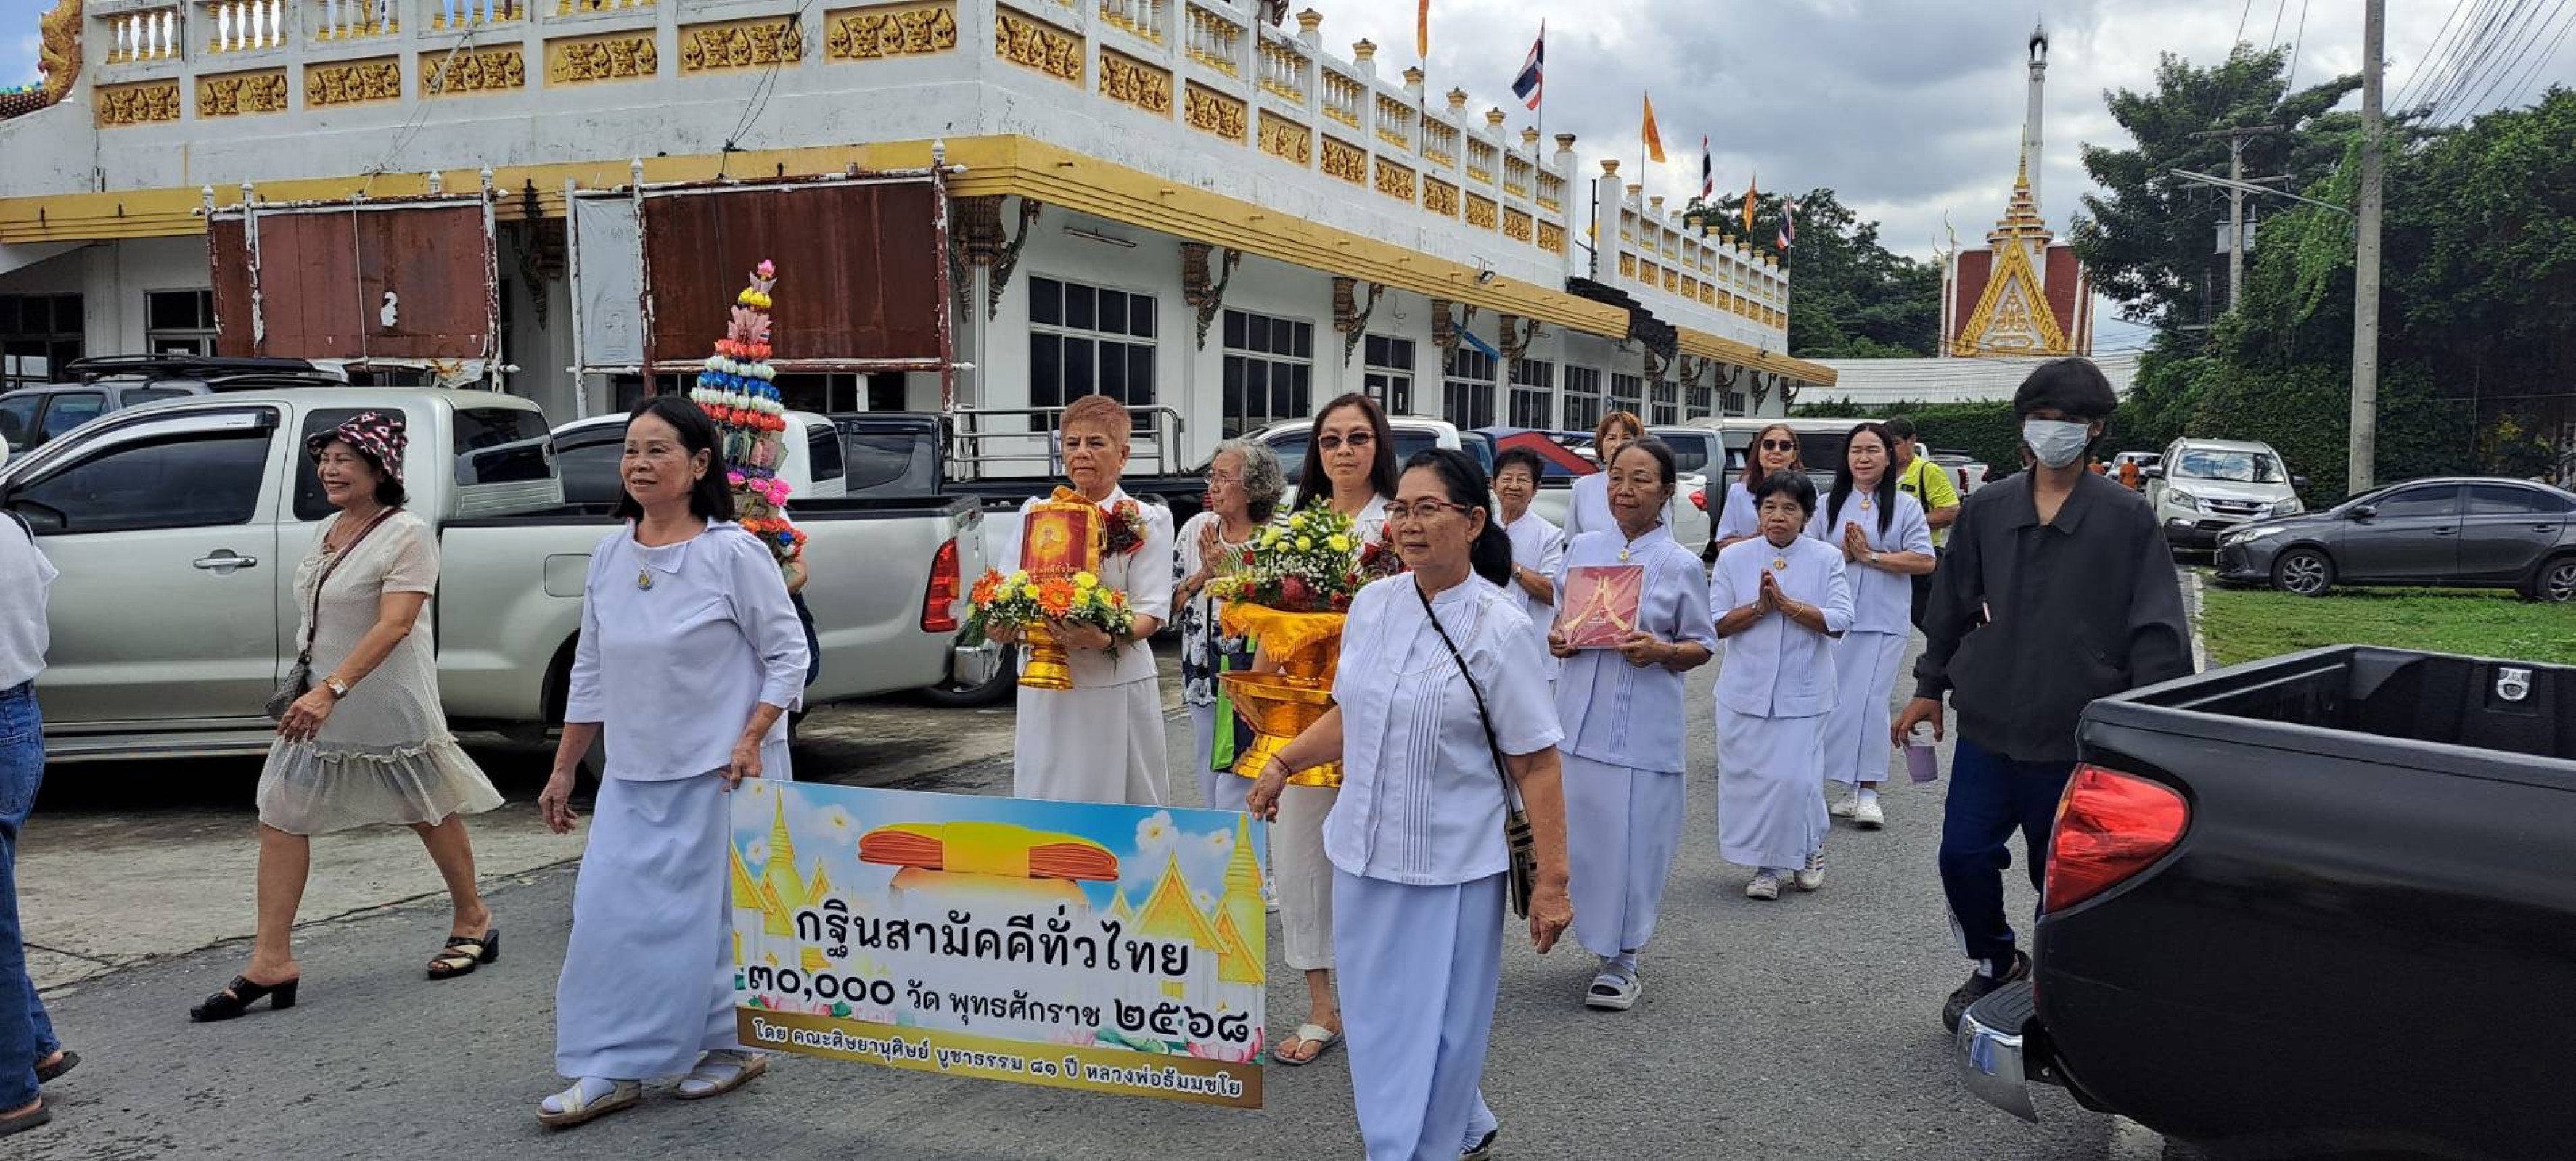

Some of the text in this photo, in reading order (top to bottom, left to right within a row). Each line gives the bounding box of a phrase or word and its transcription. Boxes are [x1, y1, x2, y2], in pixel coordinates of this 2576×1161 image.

[797, 898, 1189, 977] กฐินสามัคคีทั่วไทย
[748, 964, 1250, 1043] ๓๐,๐๐๐ วัด พุทธศักราช ๒๕๖๘
[754, 1019, 787, 1040] โดย
[792, 1029, 930, 1064] คณะศิษยานุศิษย์
[1030, 1060, 1058, 1077] ๘๑
[1065, 1057, 1078, 1078] ปี
